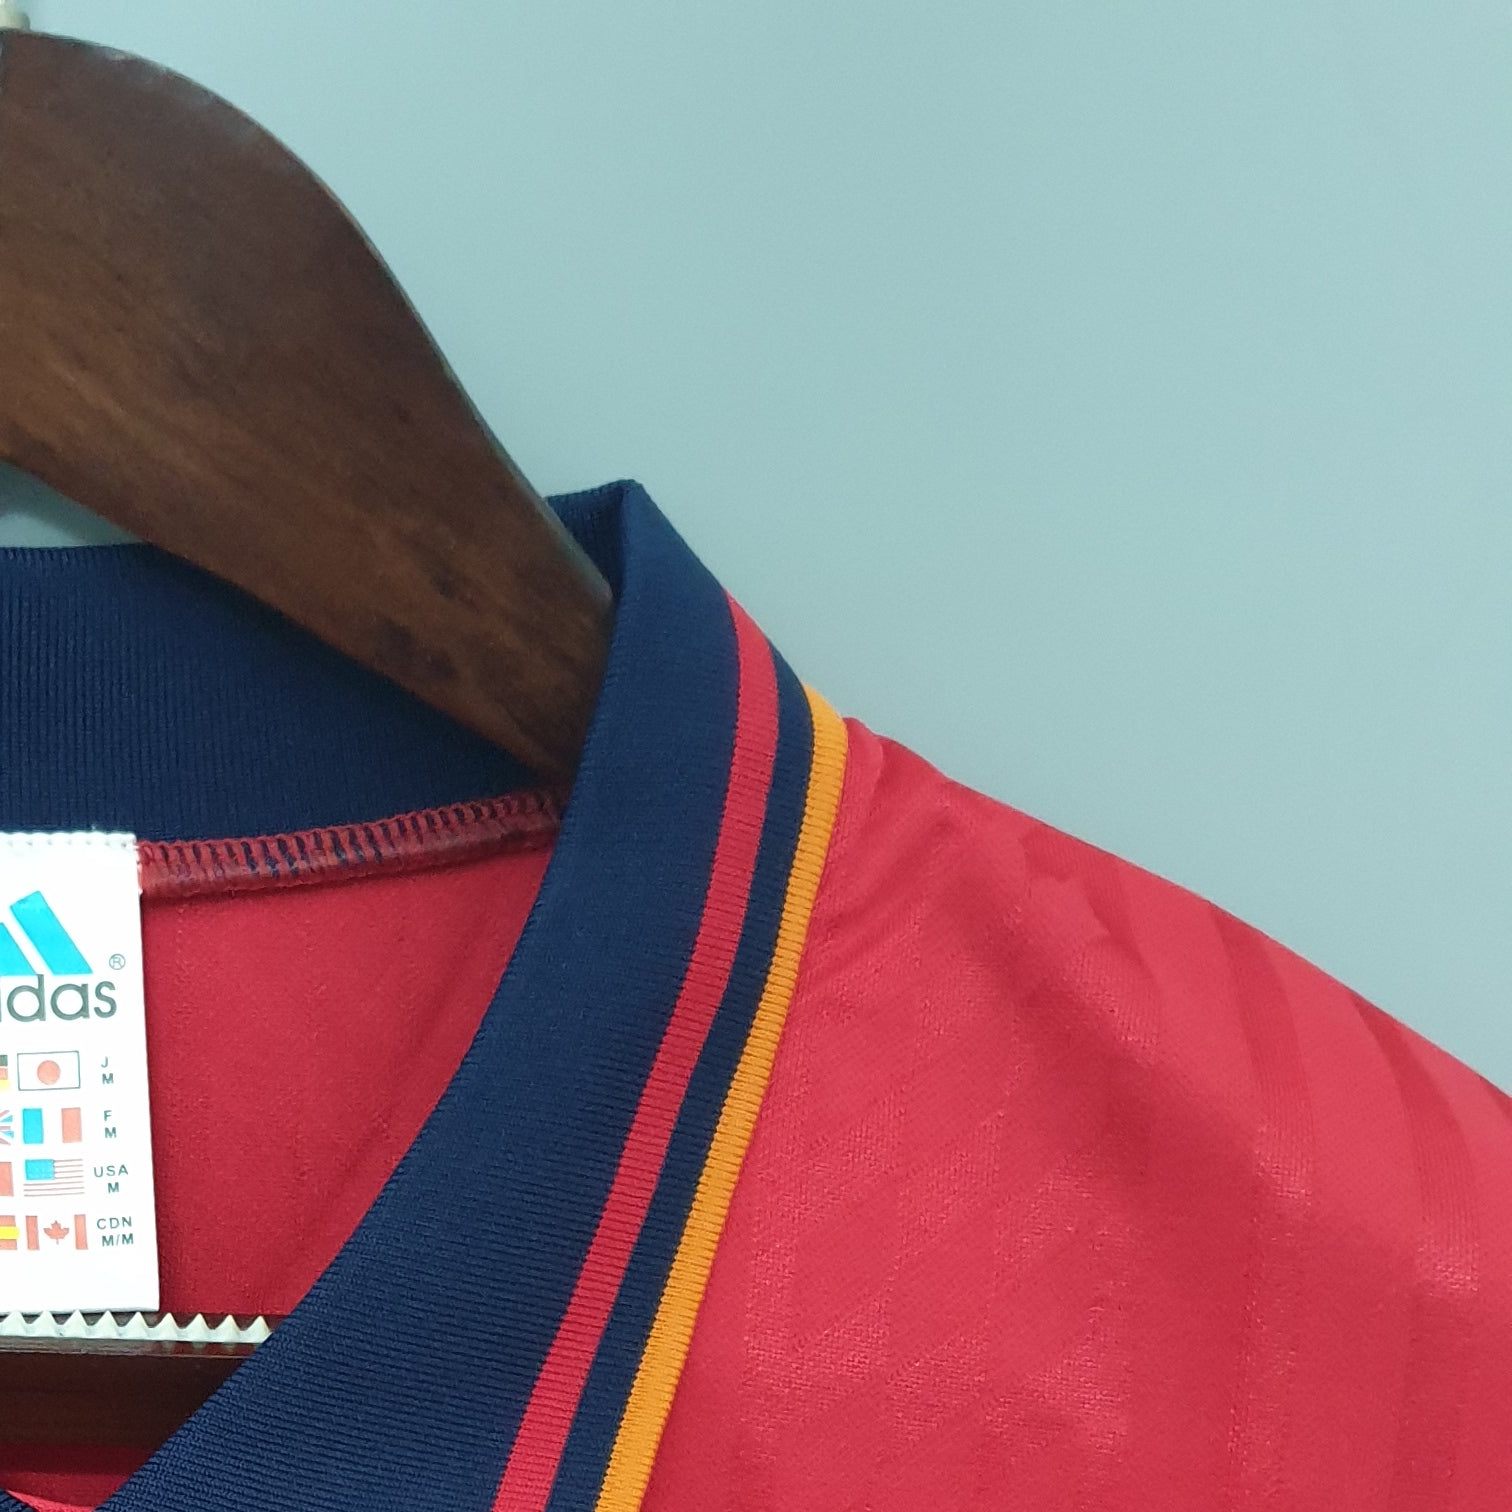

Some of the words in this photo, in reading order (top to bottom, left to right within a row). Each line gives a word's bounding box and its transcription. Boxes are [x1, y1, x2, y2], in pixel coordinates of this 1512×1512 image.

[100, 1056, 109, 1069] J
[101, 1072, 114, 1085] M
[103, 1109, 112, 1122] F
[104, 1126, 117, 1139] M
[93, 1164, 129, 1178] USA
[107, 1181, 120, 1194] M
[96, 1216, 133, 1230] CDN
[101, 1232, 134, 1247] M/M
